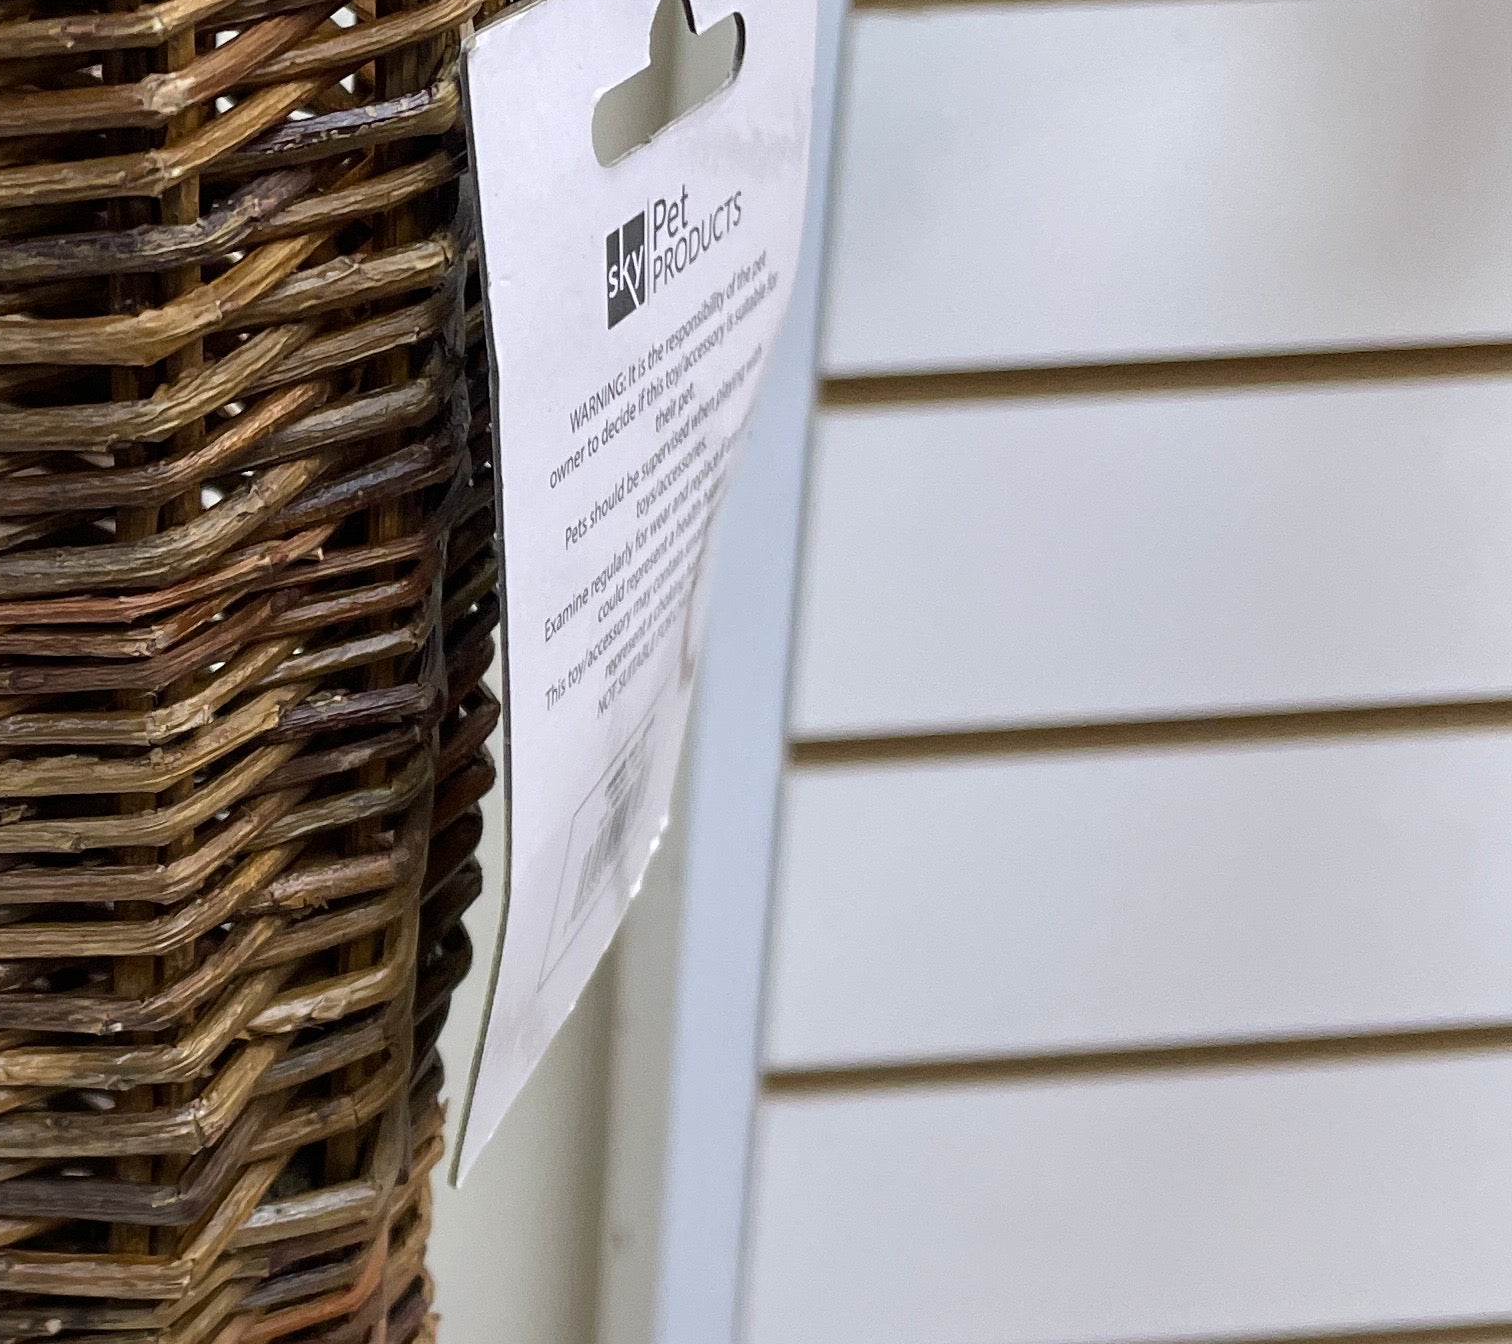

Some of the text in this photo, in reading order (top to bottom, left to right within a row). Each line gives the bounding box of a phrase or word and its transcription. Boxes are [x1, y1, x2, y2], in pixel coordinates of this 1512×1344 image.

[652, 190, 743, 294] PRODUCTS
[653, 184, 689, 251] Pet
[607, 224, 645, 308] sky
[570, 371, 627, 433] WARNING:
[628, 364, 637, 388] It
[638, 356, 646, 379] is
[648, 343, 663, 371] the
[665, 287, 726, 353] responsibility
[726, 272, 737, 299] of
[737, 265, 752, 291] the
[549, 446, 586, 489] owner
[587, 433, 599, 457] to
[601, 403, 637, 446] decide
[638, 390, 647, 415] if
[647, 379, 664, 407] this
[665, 325, 726, 390] toy/accessory
[726, 311, 734, 333] is
[655, 397, 677, 433] their
[564, 517, 587, 550] Pets
[588, 484, 625, 529] should
[626, 471, 640, 495] be
[641, 414, 690, 481] supervised
[691, 396, 715, 431] when
[544, 587, 589, 643] Examine
[590, 541, 633, 597] regularly
[635, 527, 648, 553] for
[649, 506, 671, 536] wear
[672, 485, 689, 514] and
[597, 583, 625, 623] could
[626, 542, 669, 594] represent
[544, 678, 567, 711] This
[567, 608, 631, 690] toy/accessory
[632, 586, 651, 619] may
[604, 631, 647, 679] represent
[596, 678, 618, 719] NOT
